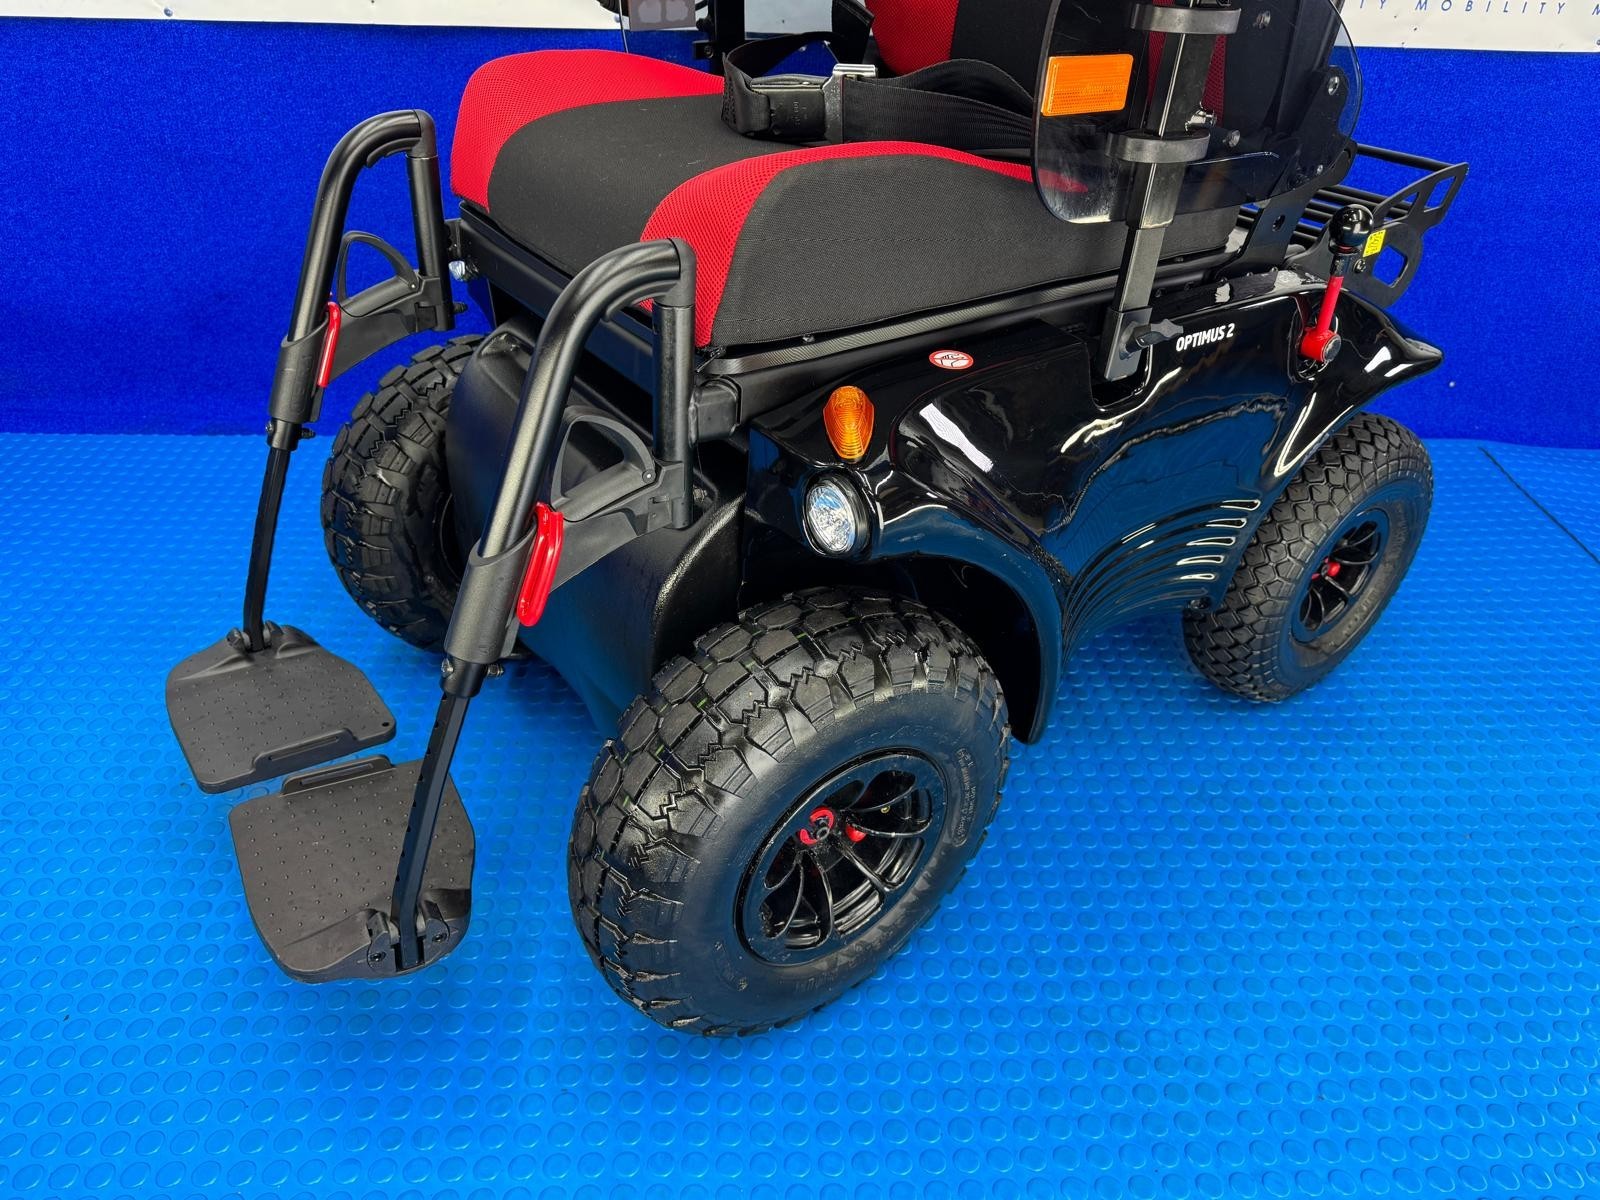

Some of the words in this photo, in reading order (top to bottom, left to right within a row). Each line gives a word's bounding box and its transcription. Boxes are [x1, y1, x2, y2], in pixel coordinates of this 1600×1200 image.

[1415, 0, 1566, 15] MOBILITY
[1175, 325, 1226, 352] OPTIMUS
[1226, 322, 1236, 338] 2
